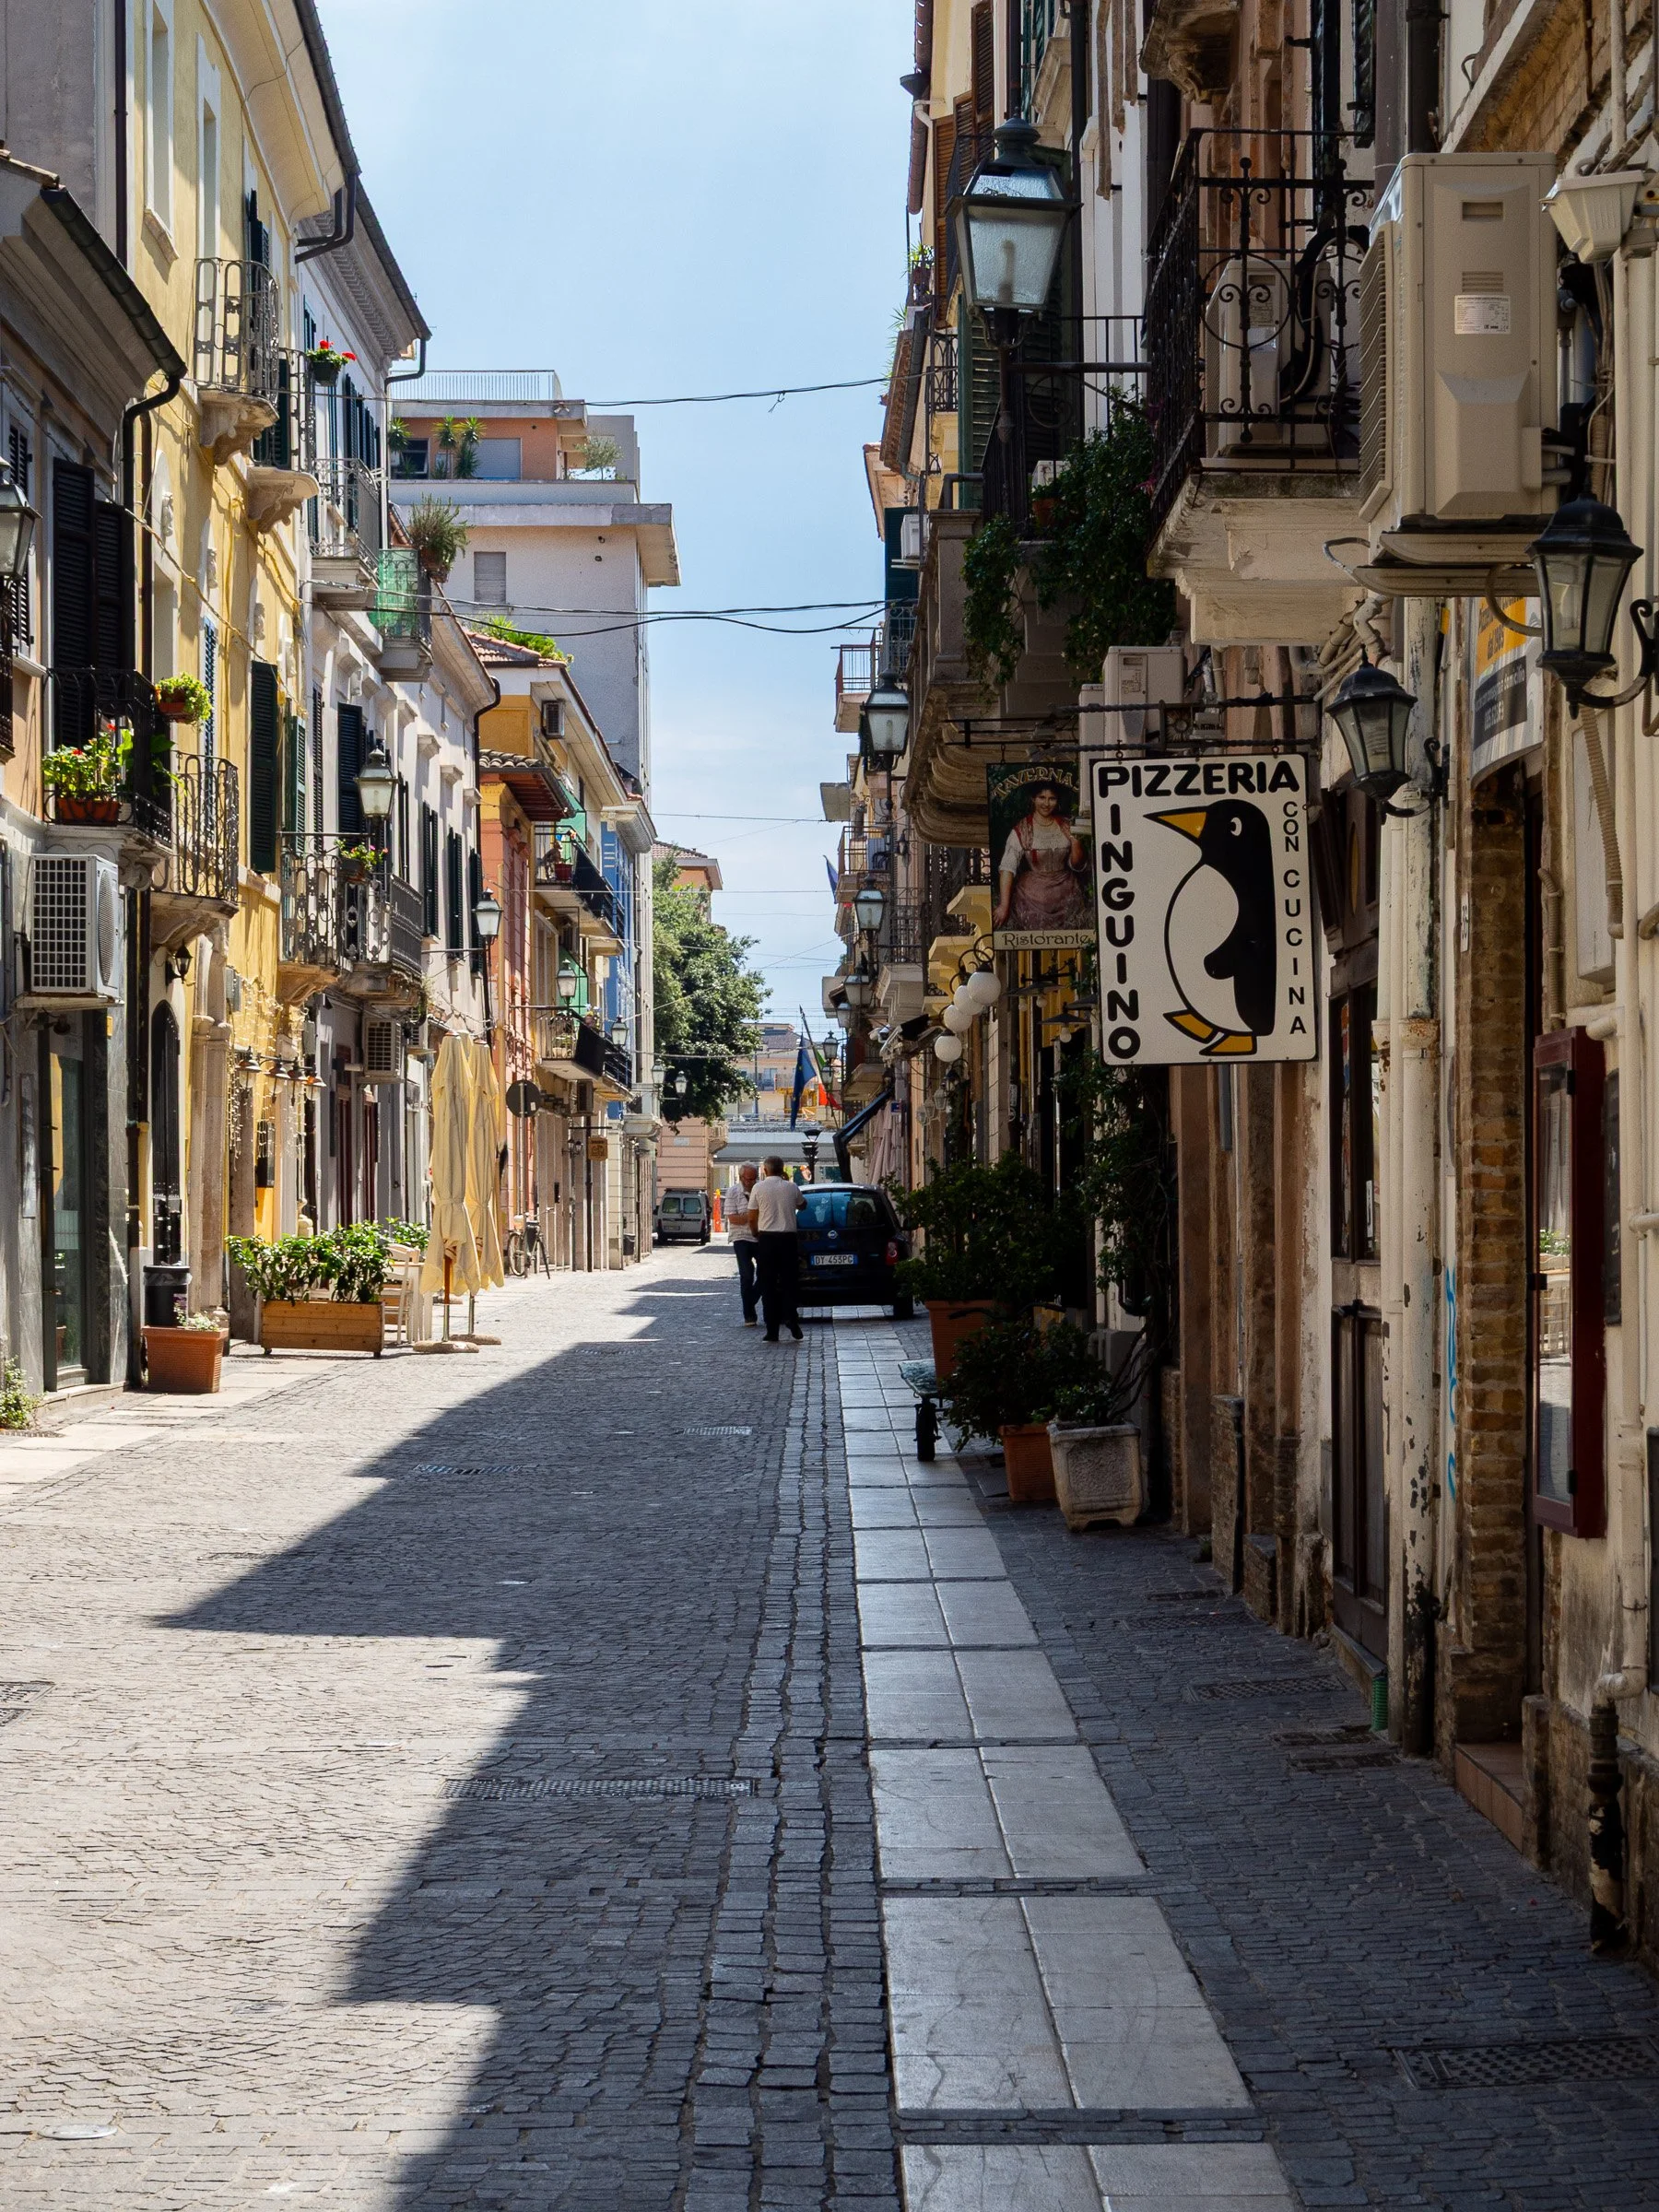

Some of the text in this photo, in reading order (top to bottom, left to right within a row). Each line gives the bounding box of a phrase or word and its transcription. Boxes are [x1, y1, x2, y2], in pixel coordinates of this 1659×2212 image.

[992, 765, 1075, 801] TAVERNA
[1098, 760, 1300, 799] PIZZERIA
[1282, 801, 1308, 1035] CON CUCINA
[1002, 931, 1089, 947] Ristorante
